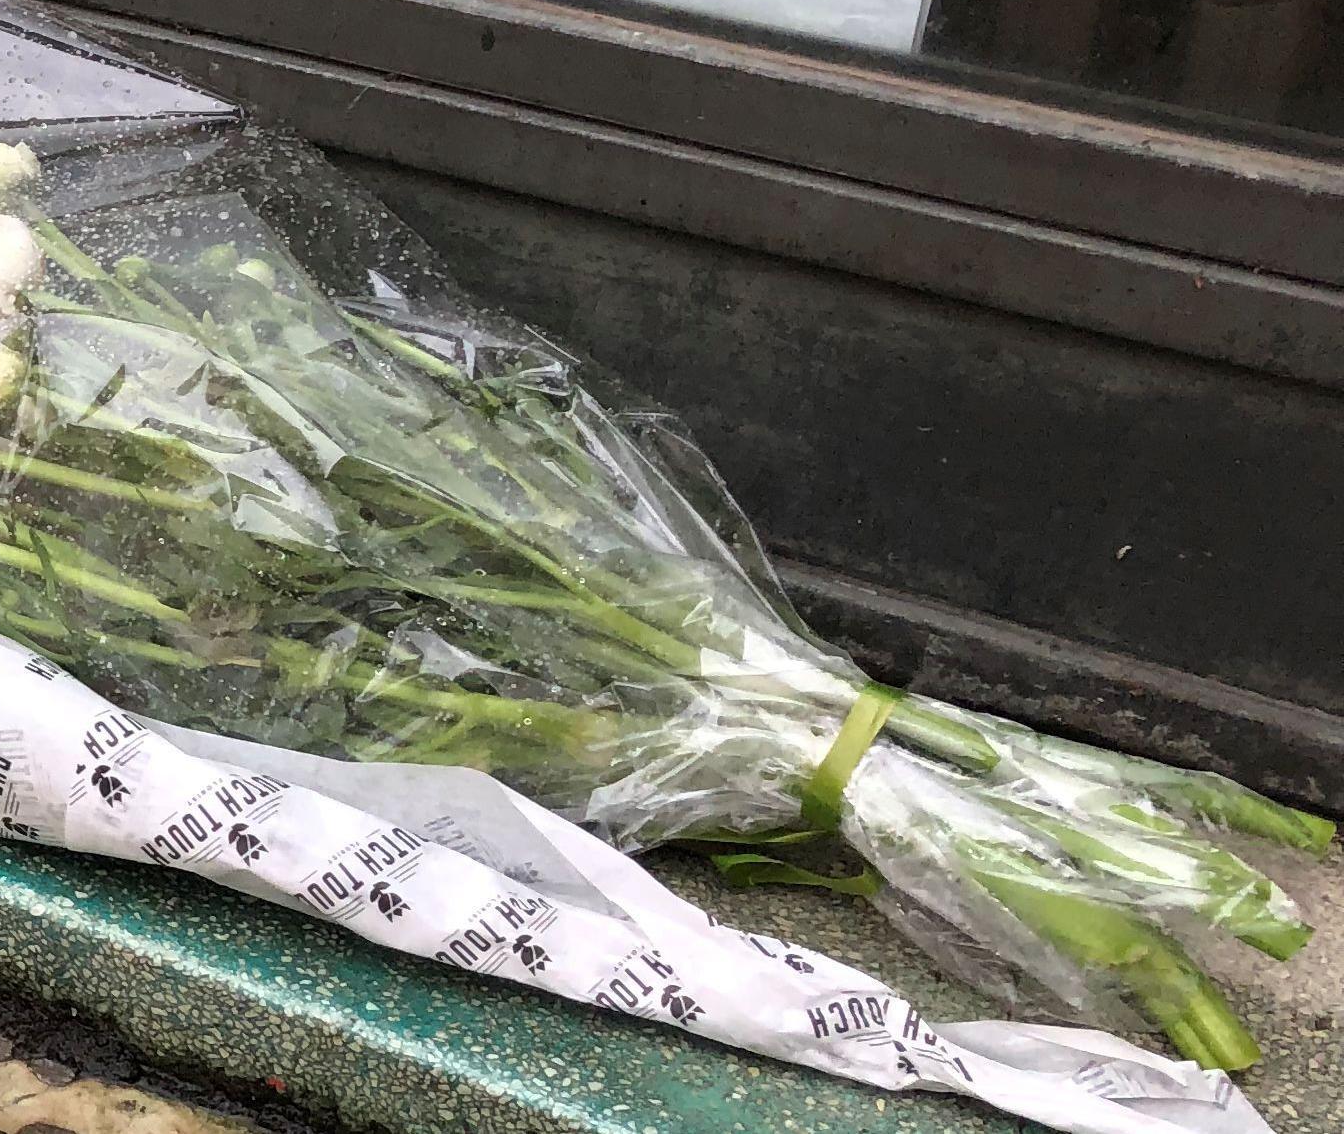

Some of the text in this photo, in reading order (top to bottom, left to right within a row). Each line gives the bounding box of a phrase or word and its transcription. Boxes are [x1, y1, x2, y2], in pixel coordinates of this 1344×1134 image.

[84, 713, 148, 759] UTCH
[140, 774, 291, 865] DUTCH TOUCH
[354, 827, 428, 876] UTCH
